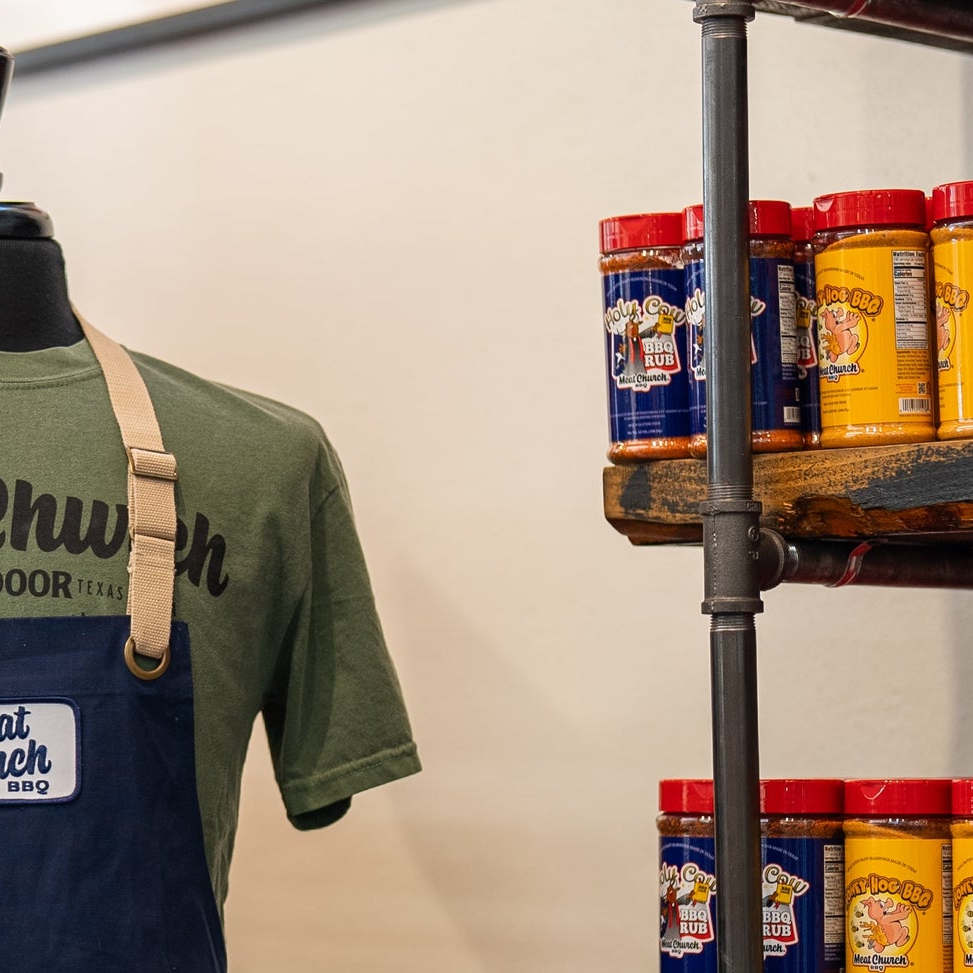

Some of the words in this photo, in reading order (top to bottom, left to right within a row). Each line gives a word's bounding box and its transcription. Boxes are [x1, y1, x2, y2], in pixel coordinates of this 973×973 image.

[825, 287, 849, 305] HOG
[852, 290, 882, 314] BBQ
[945, 285, 968, 309] BBQ
[685, 289, 705, 318] Hol
[605, 299, 640, 328] Holy
[645, 297, 685, 323] Cow
[644, 342, 674, 354] BBQ
[644, 354, 675, 367] RUB
[829, 365, 858, 375] Church
[619, 375, 636, 385] Meat
[636, 373, 667, 384] Church
[77, 578, 123, 600] TEXAS
[7, 779, 50, 794] BBQ
[764, 866, 807, 893] Cow
[870, 876, 900, 894] HOG
[902, 882, 932, 908] BBQ
[680, 910, 708, 922] BBQ
[762, 912, 791, 924] BBQ
[680, 922, 708, 934] RUB
[762, 924, 791, 936] RUB
[672, 940, 699, 949] Church
[854, 954, 871, 964] Meat
[872, 954, 906, 966] Church
